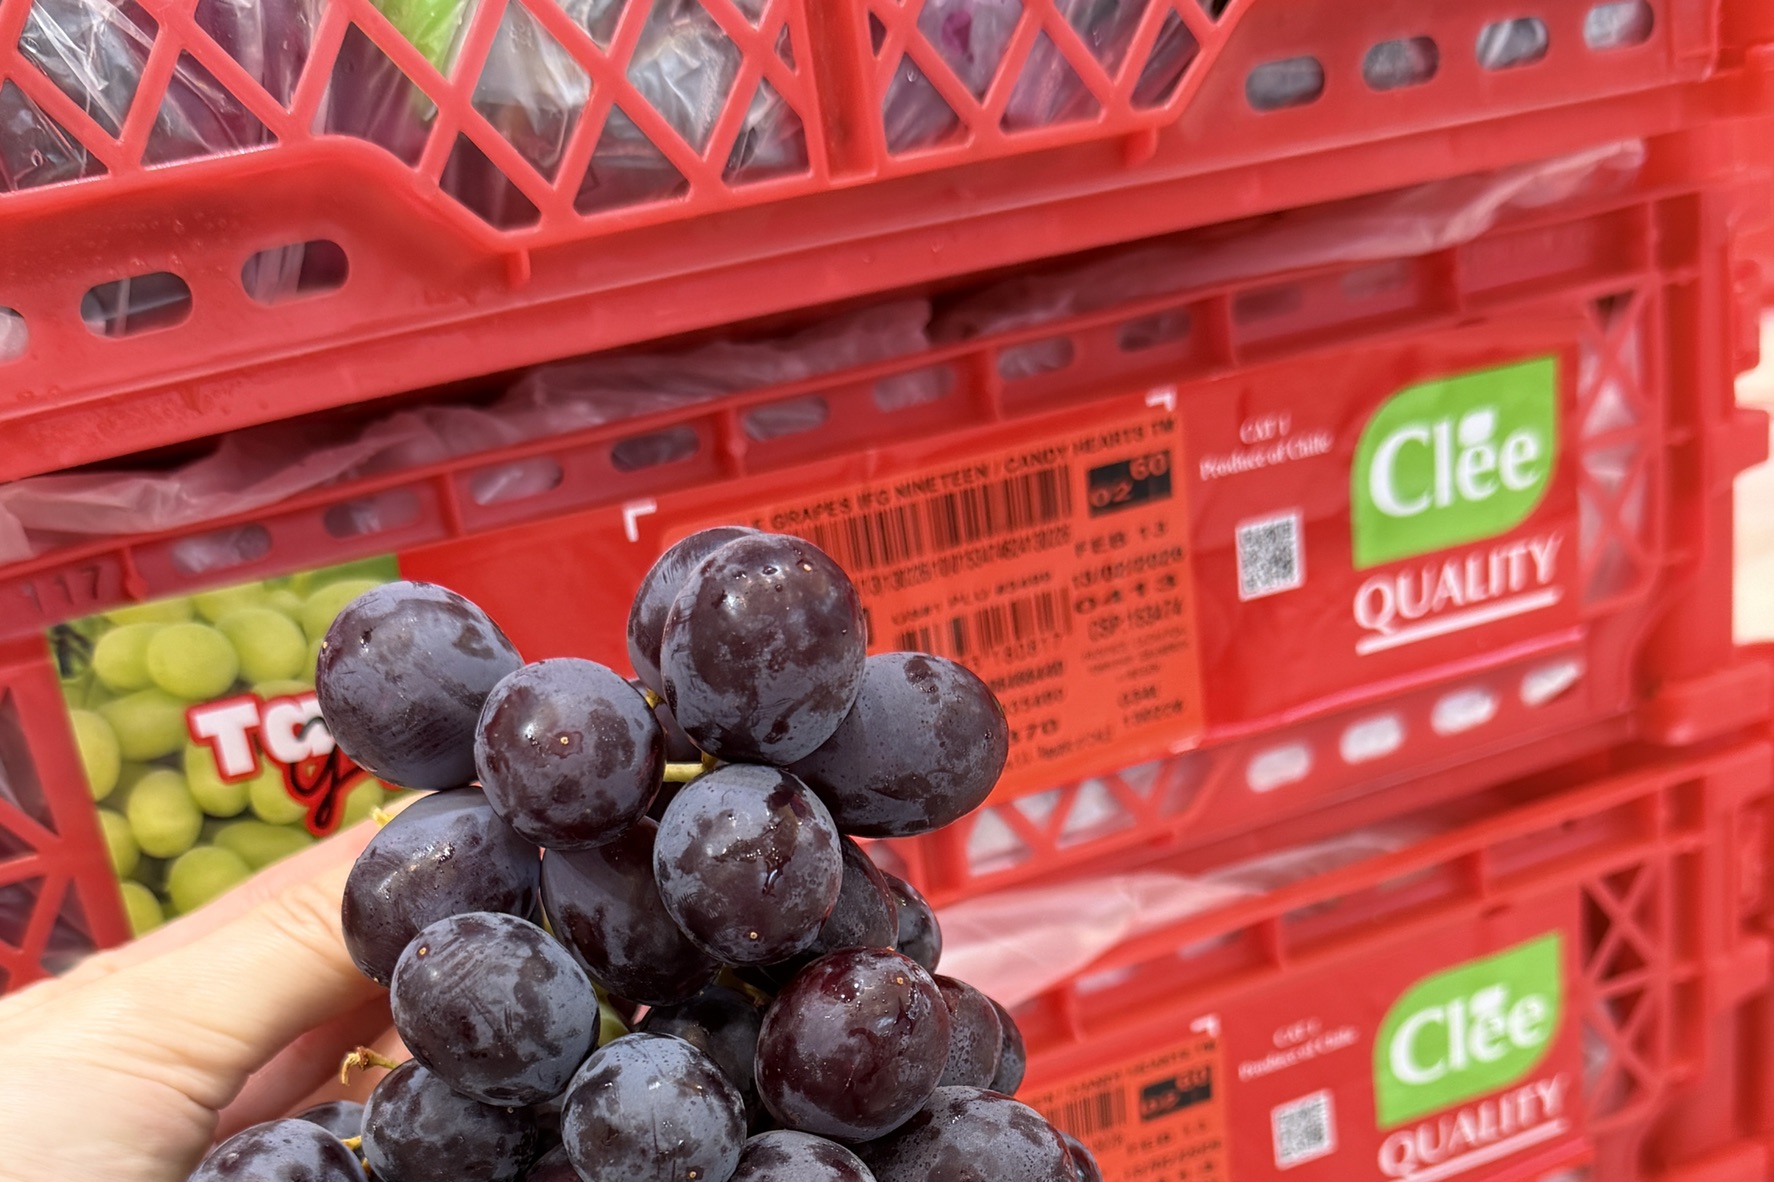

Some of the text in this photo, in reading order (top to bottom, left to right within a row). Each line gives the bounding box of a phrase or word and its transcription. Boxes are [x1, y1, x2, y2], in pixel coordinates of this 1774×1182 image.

[771, 497, 852, 530] GRAPES
[894, 464, 988, 498] NINETEEN
[1005, 446, 1067, 474] CANDY
[1073, 425, 1144, 454] HEARTS
[1354, 534, 1562, 635] QUALITY
[1378, 1074, 1567, 1180] QUALITY
